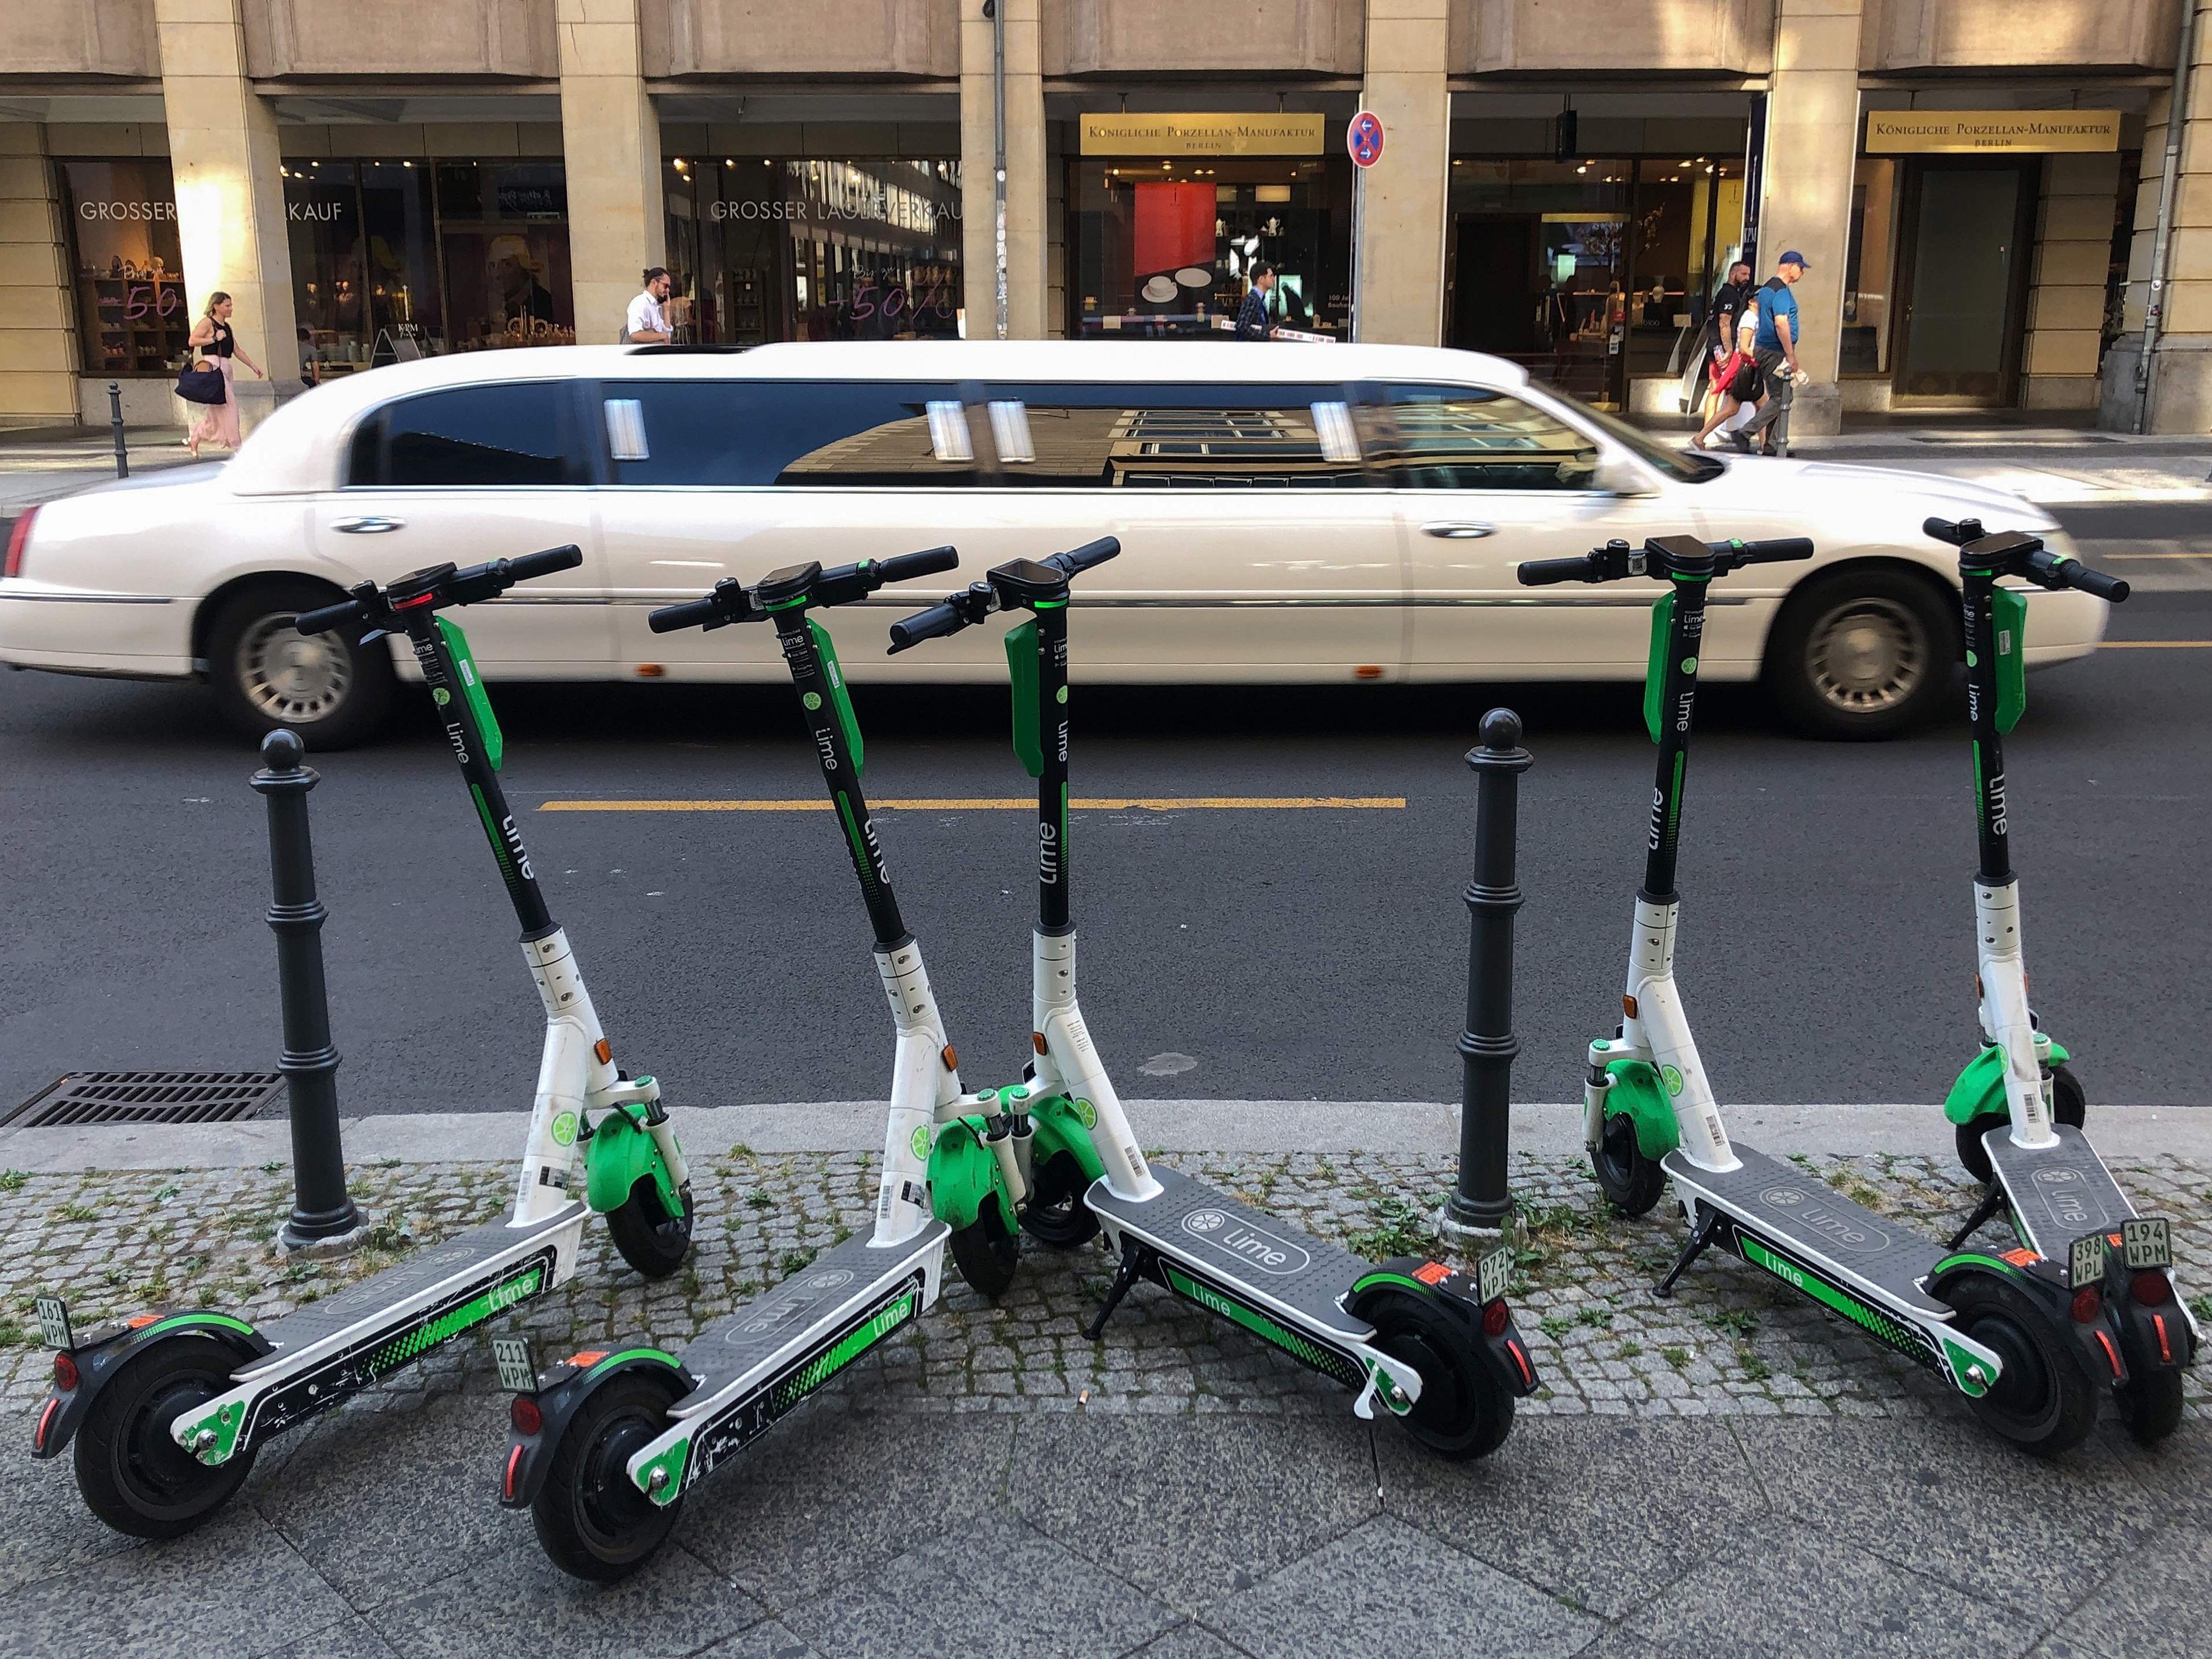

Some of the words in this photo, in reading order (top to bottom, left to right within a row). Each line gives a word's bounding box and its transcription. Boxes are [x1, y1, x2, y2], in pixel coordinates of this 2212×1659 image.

[1167, 125, 1316, 138] PORZELLAN-MANUFAKTUR
[1876, 123, 1950, 135] KÖNIGLICHE
[1956, 122, 2111, 135] PORZELLAN-MANUFAKTUR
[1974, 138, 2012, 147] BERLIN
[80, 201, 177, 221] GROSSER
[710, 201, 807, 220] GROSSER
[2128, 1222, 2164, 1243] 194
[2076, 1236, 2101, 1262] 398
[2129, 1244, 2166, 1264] WPM
[1482, 1251, 1505, 1279] 972
[2075, 1260, 2101, 1283] WPL
[39, 1300, 62, 1322] 161
[43, 1323, 67, 1345] WPM
[496, 1343, 525, 1364] 211
[500, 1366, 531, 1388] WPM
